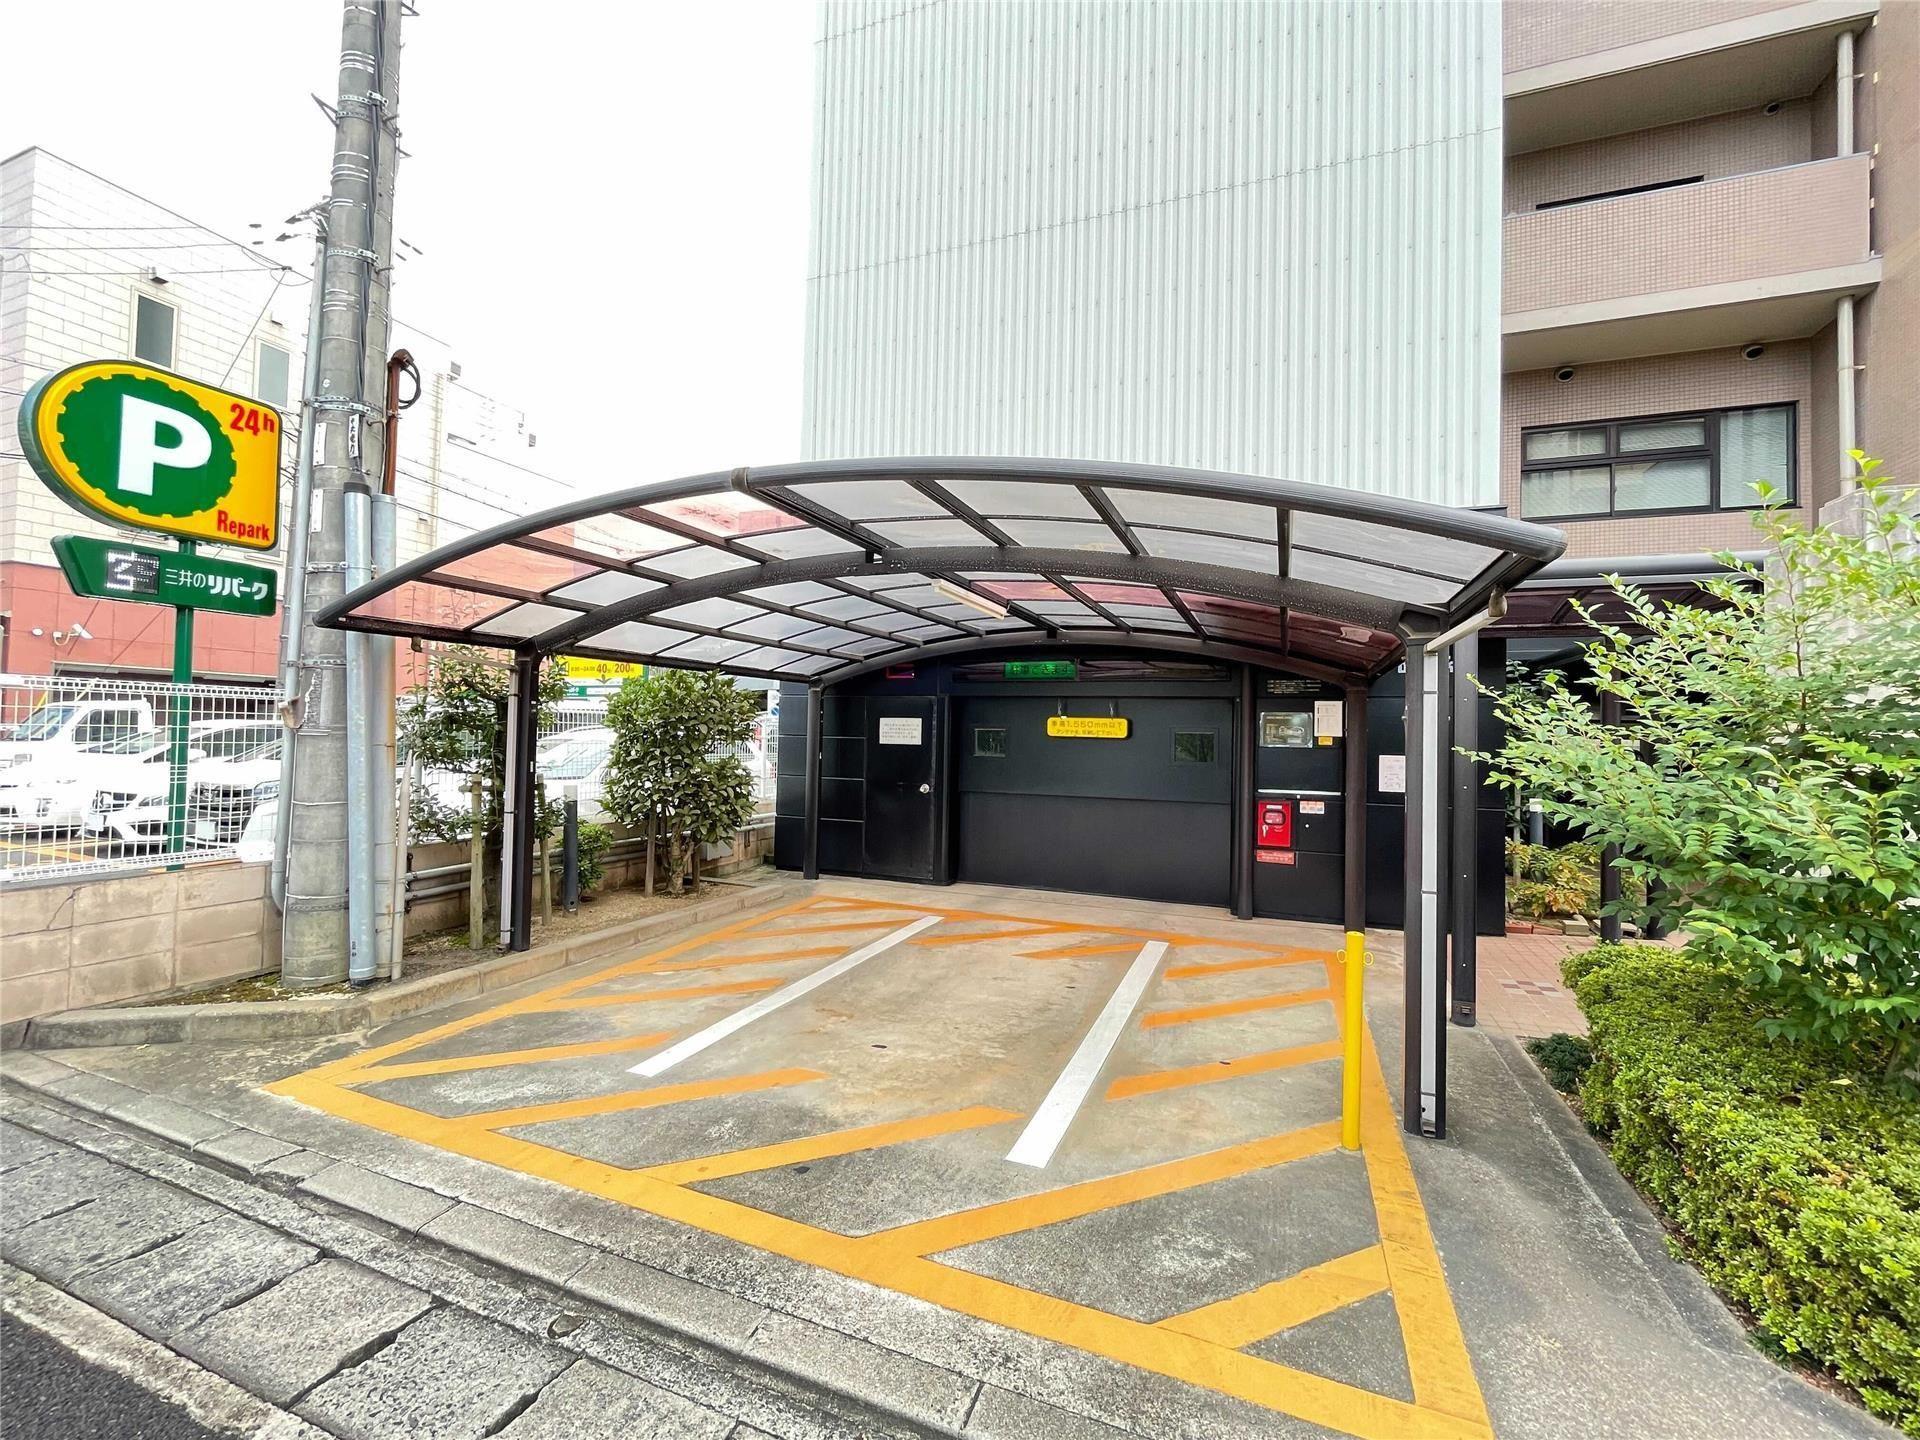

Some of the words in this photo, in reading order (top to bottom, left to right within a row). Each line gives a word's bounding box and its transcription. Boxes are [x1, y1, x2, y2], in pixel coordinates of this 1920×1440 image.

[229, 402, 276, 437] 24h
[117, 393, 213, 497] P
[217, 509, 271, 542] Repark
[164, 567, 269, 601] 三井のリパーク
